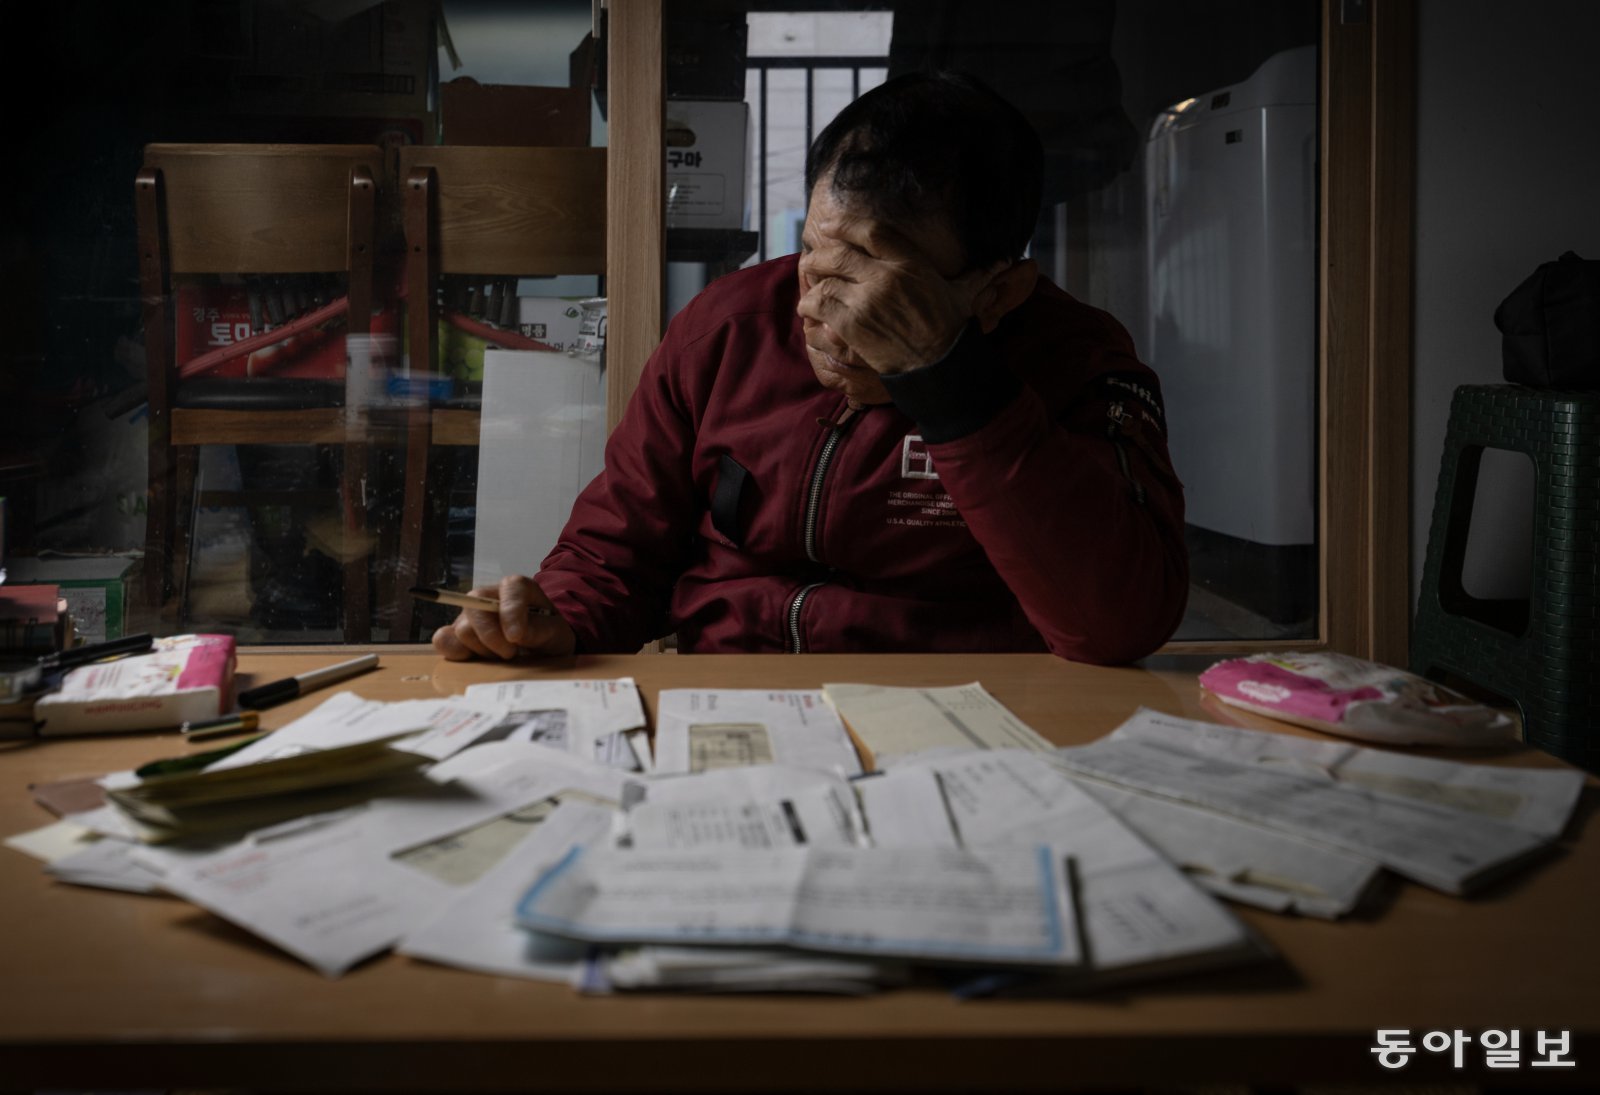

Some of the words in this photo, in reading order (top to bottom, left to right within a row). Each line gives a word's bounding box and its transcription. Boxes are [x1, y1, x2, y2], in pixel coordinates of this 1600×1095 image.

[667, 151, 703, 168] 구마
[192, 306, 221, 322] 경주
[902, 492, 934, 500] ORIGINAL
[906, 518, 934, 527] QUALITY
